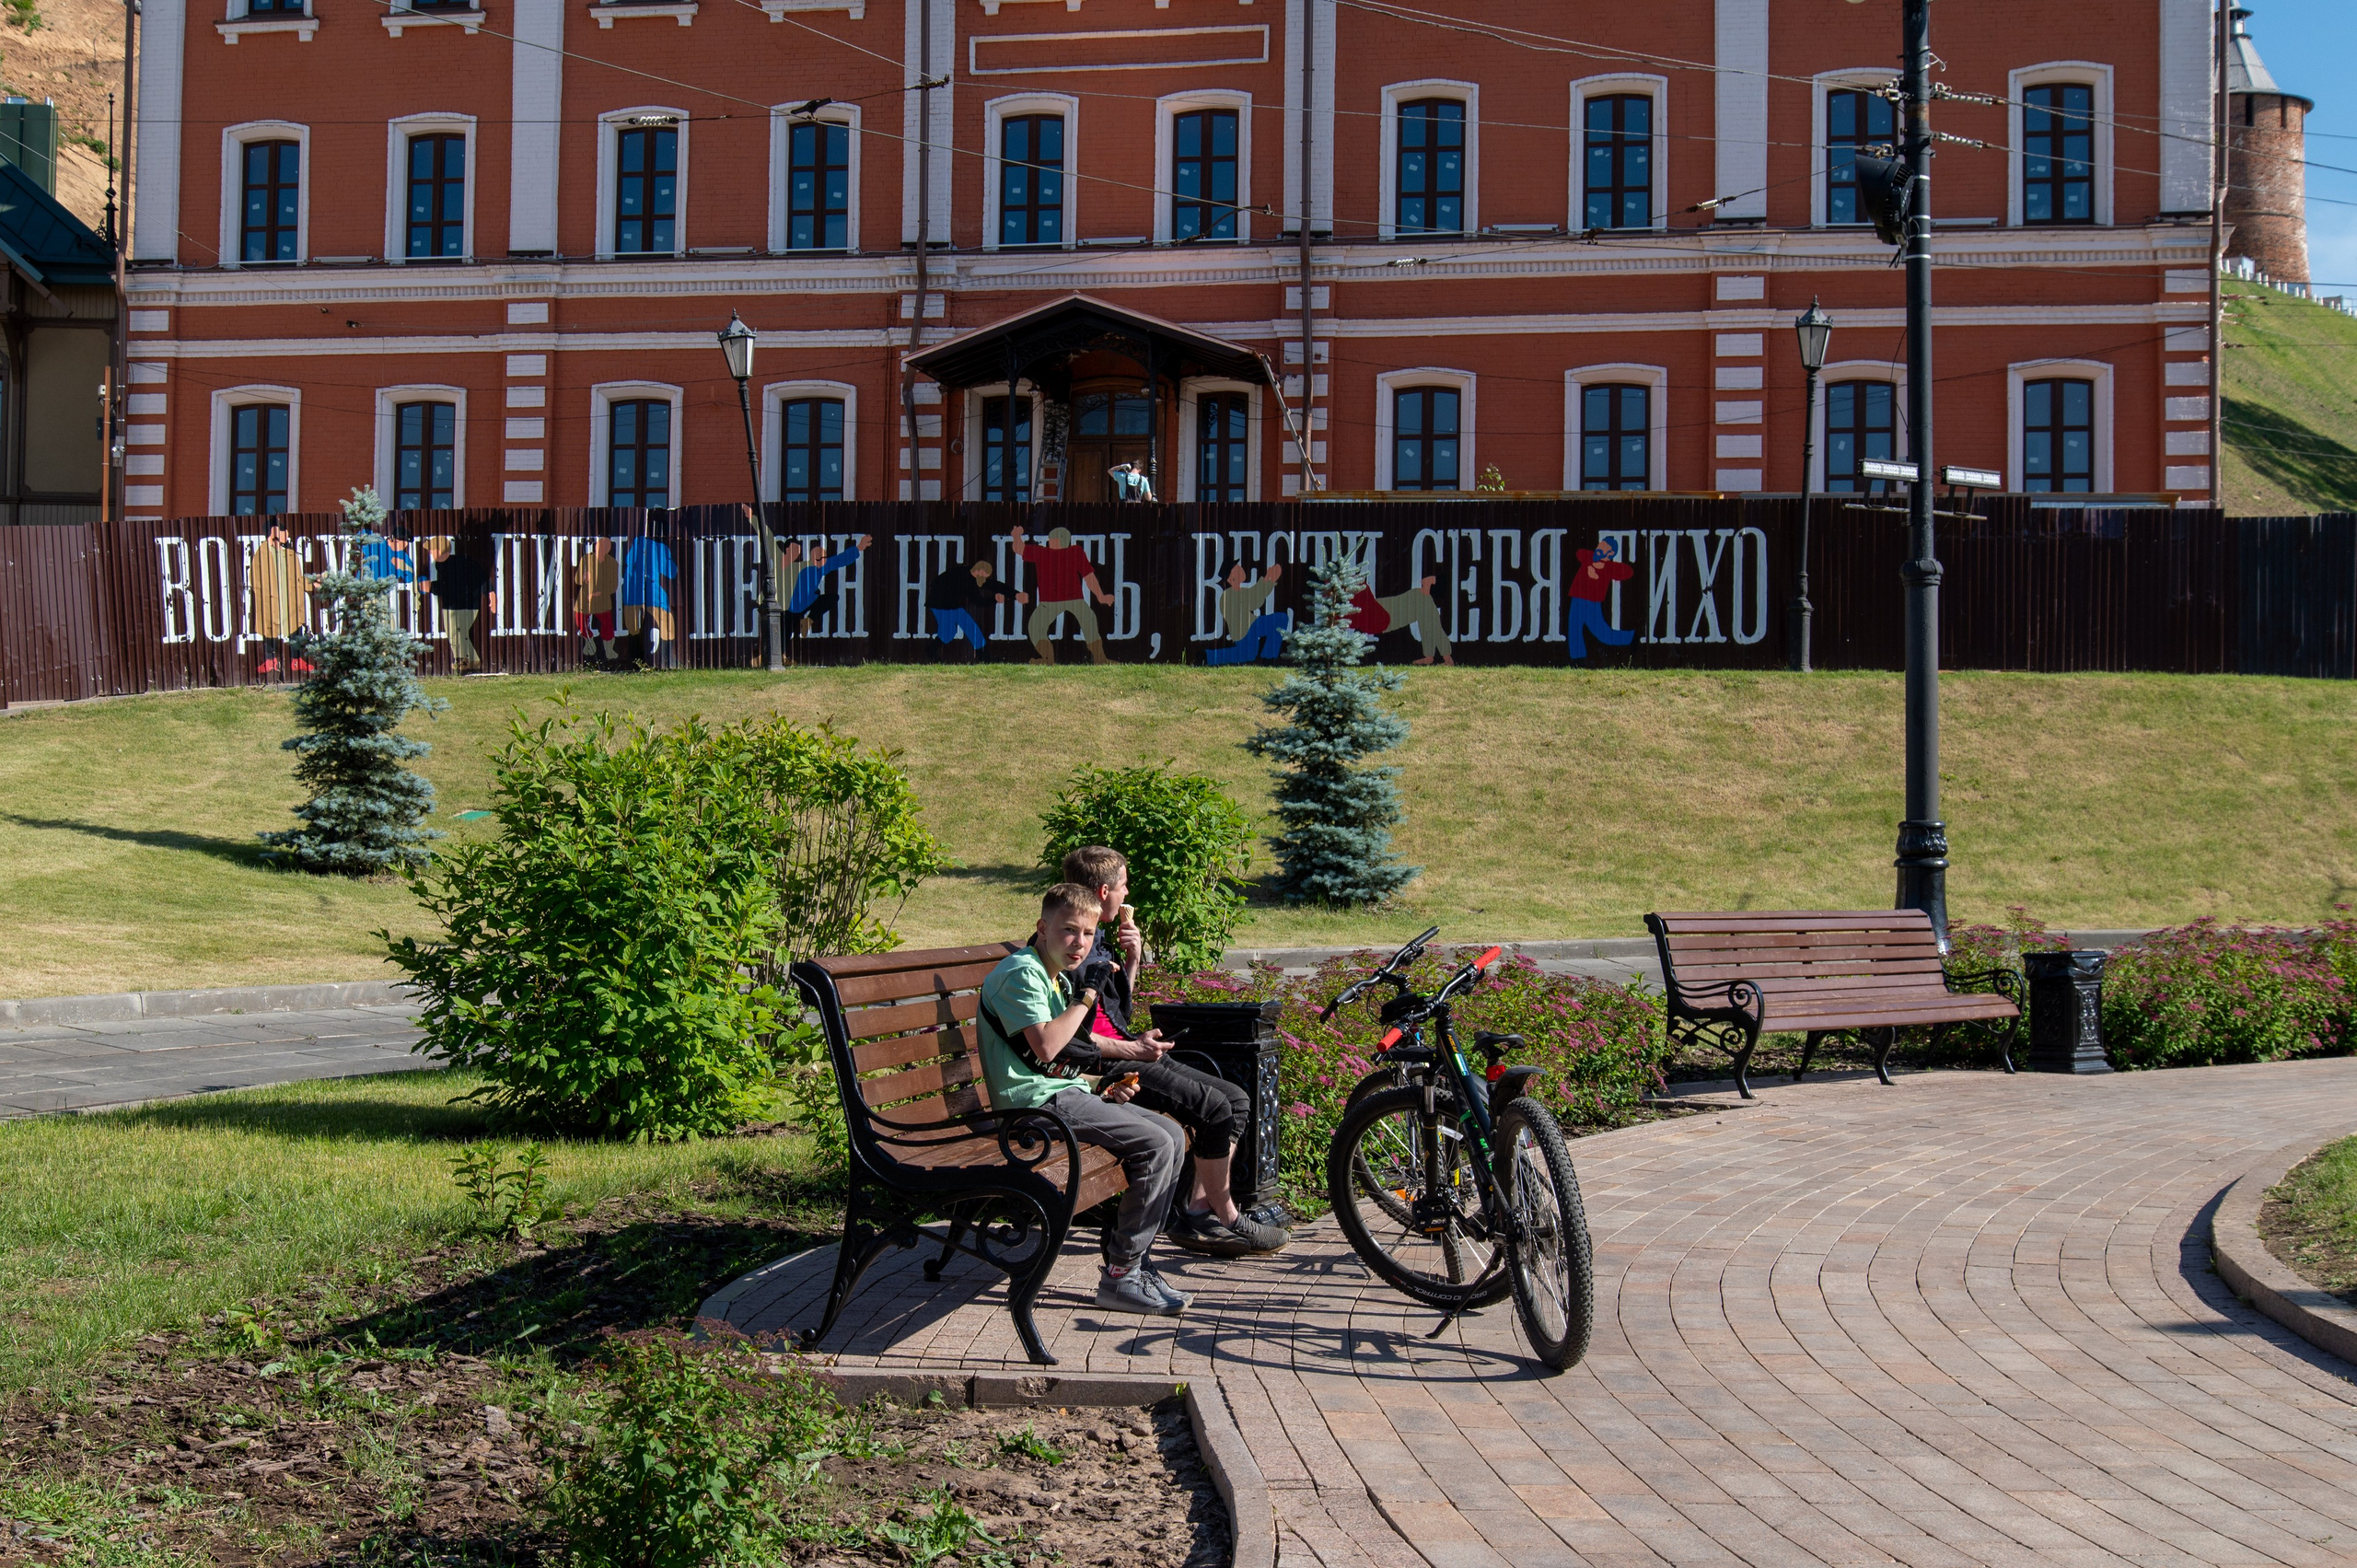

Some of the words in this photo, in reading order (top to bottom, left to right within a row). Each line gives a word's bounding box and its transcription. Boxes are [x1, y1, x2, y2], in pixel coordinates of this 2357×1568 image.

[690, 534, 869, 639] ПЕЕН
[989, 532, 1161, 658] ПТЬ,
[1409, 528, 1568, 643] СЕБЯ
[1598, 527, 1768, 645] ТИХО
[1412, 1285, 1453, 1301] CONTROL
[1453, 1290, 1488, 1301] GROD
